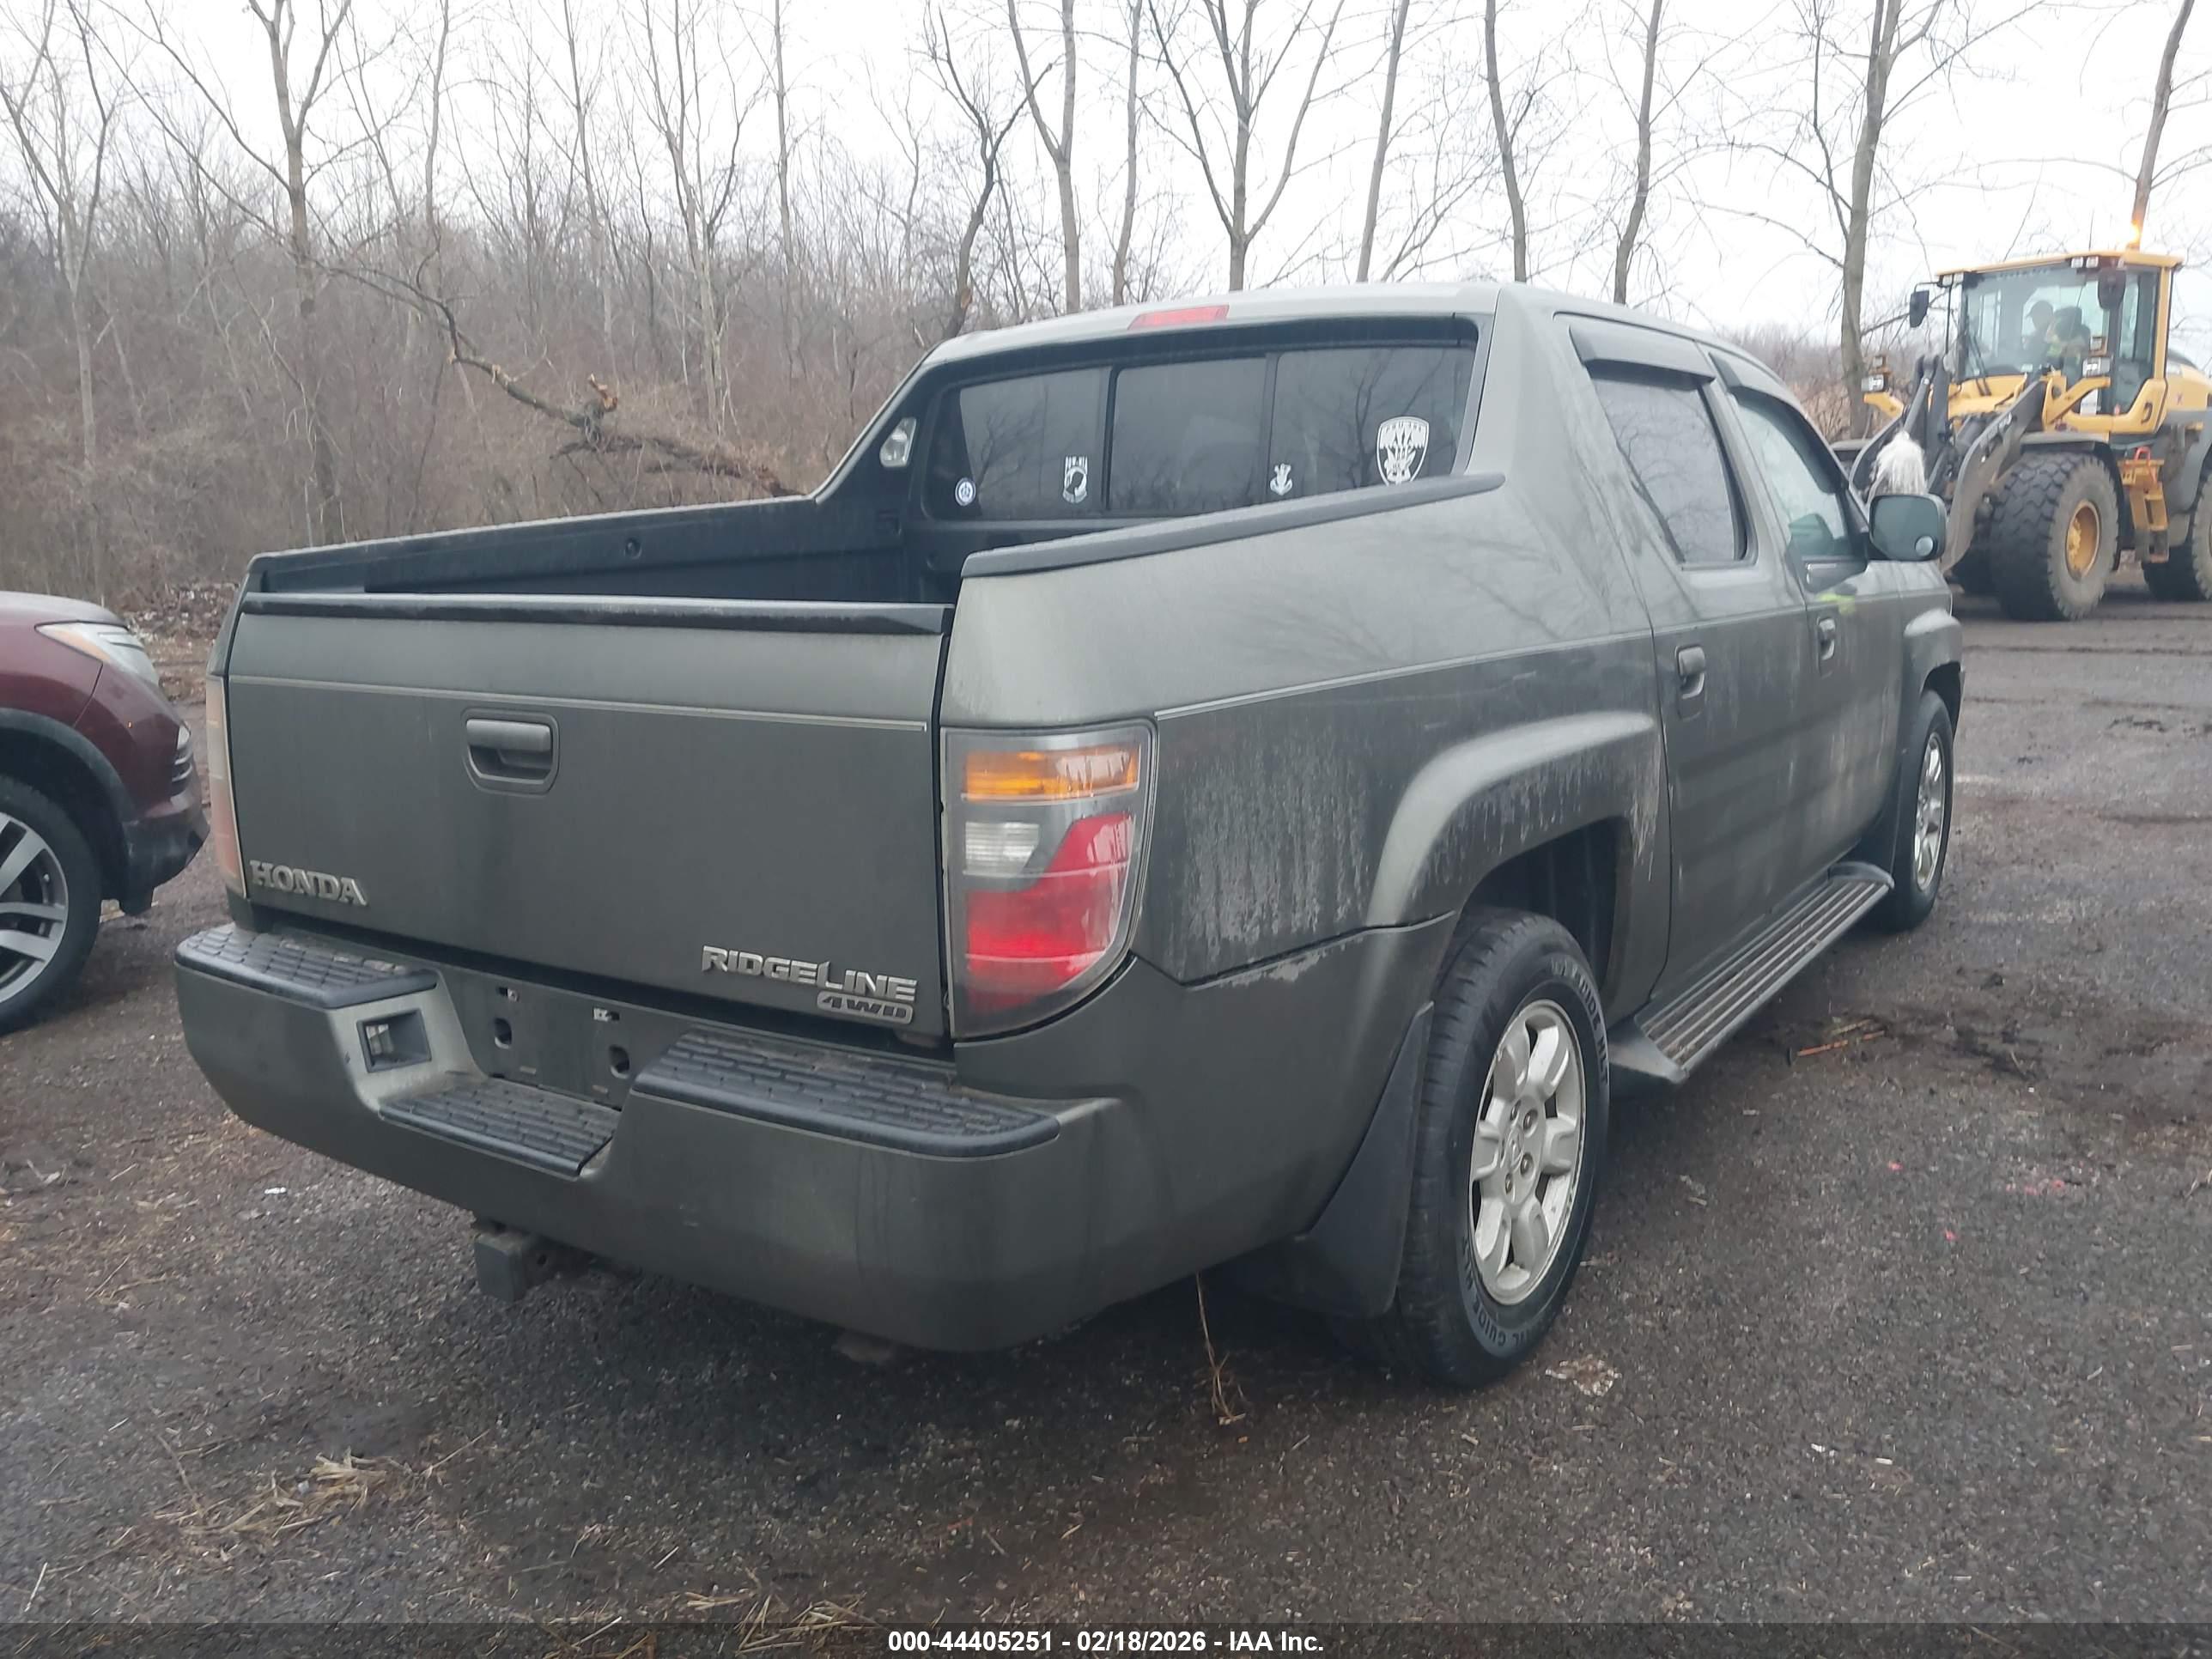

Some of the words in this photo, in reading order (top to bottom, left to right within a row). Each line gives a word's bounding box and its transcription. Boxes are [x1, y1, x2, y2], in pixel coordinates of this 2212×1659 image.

[249, 860, 368, 906] HONDA
[702, 945, 917, 1002] RIDGELINE
[819, 993, 911, 1022] 4WD
[1472, 1294, 1507, 1347] GUIDE
